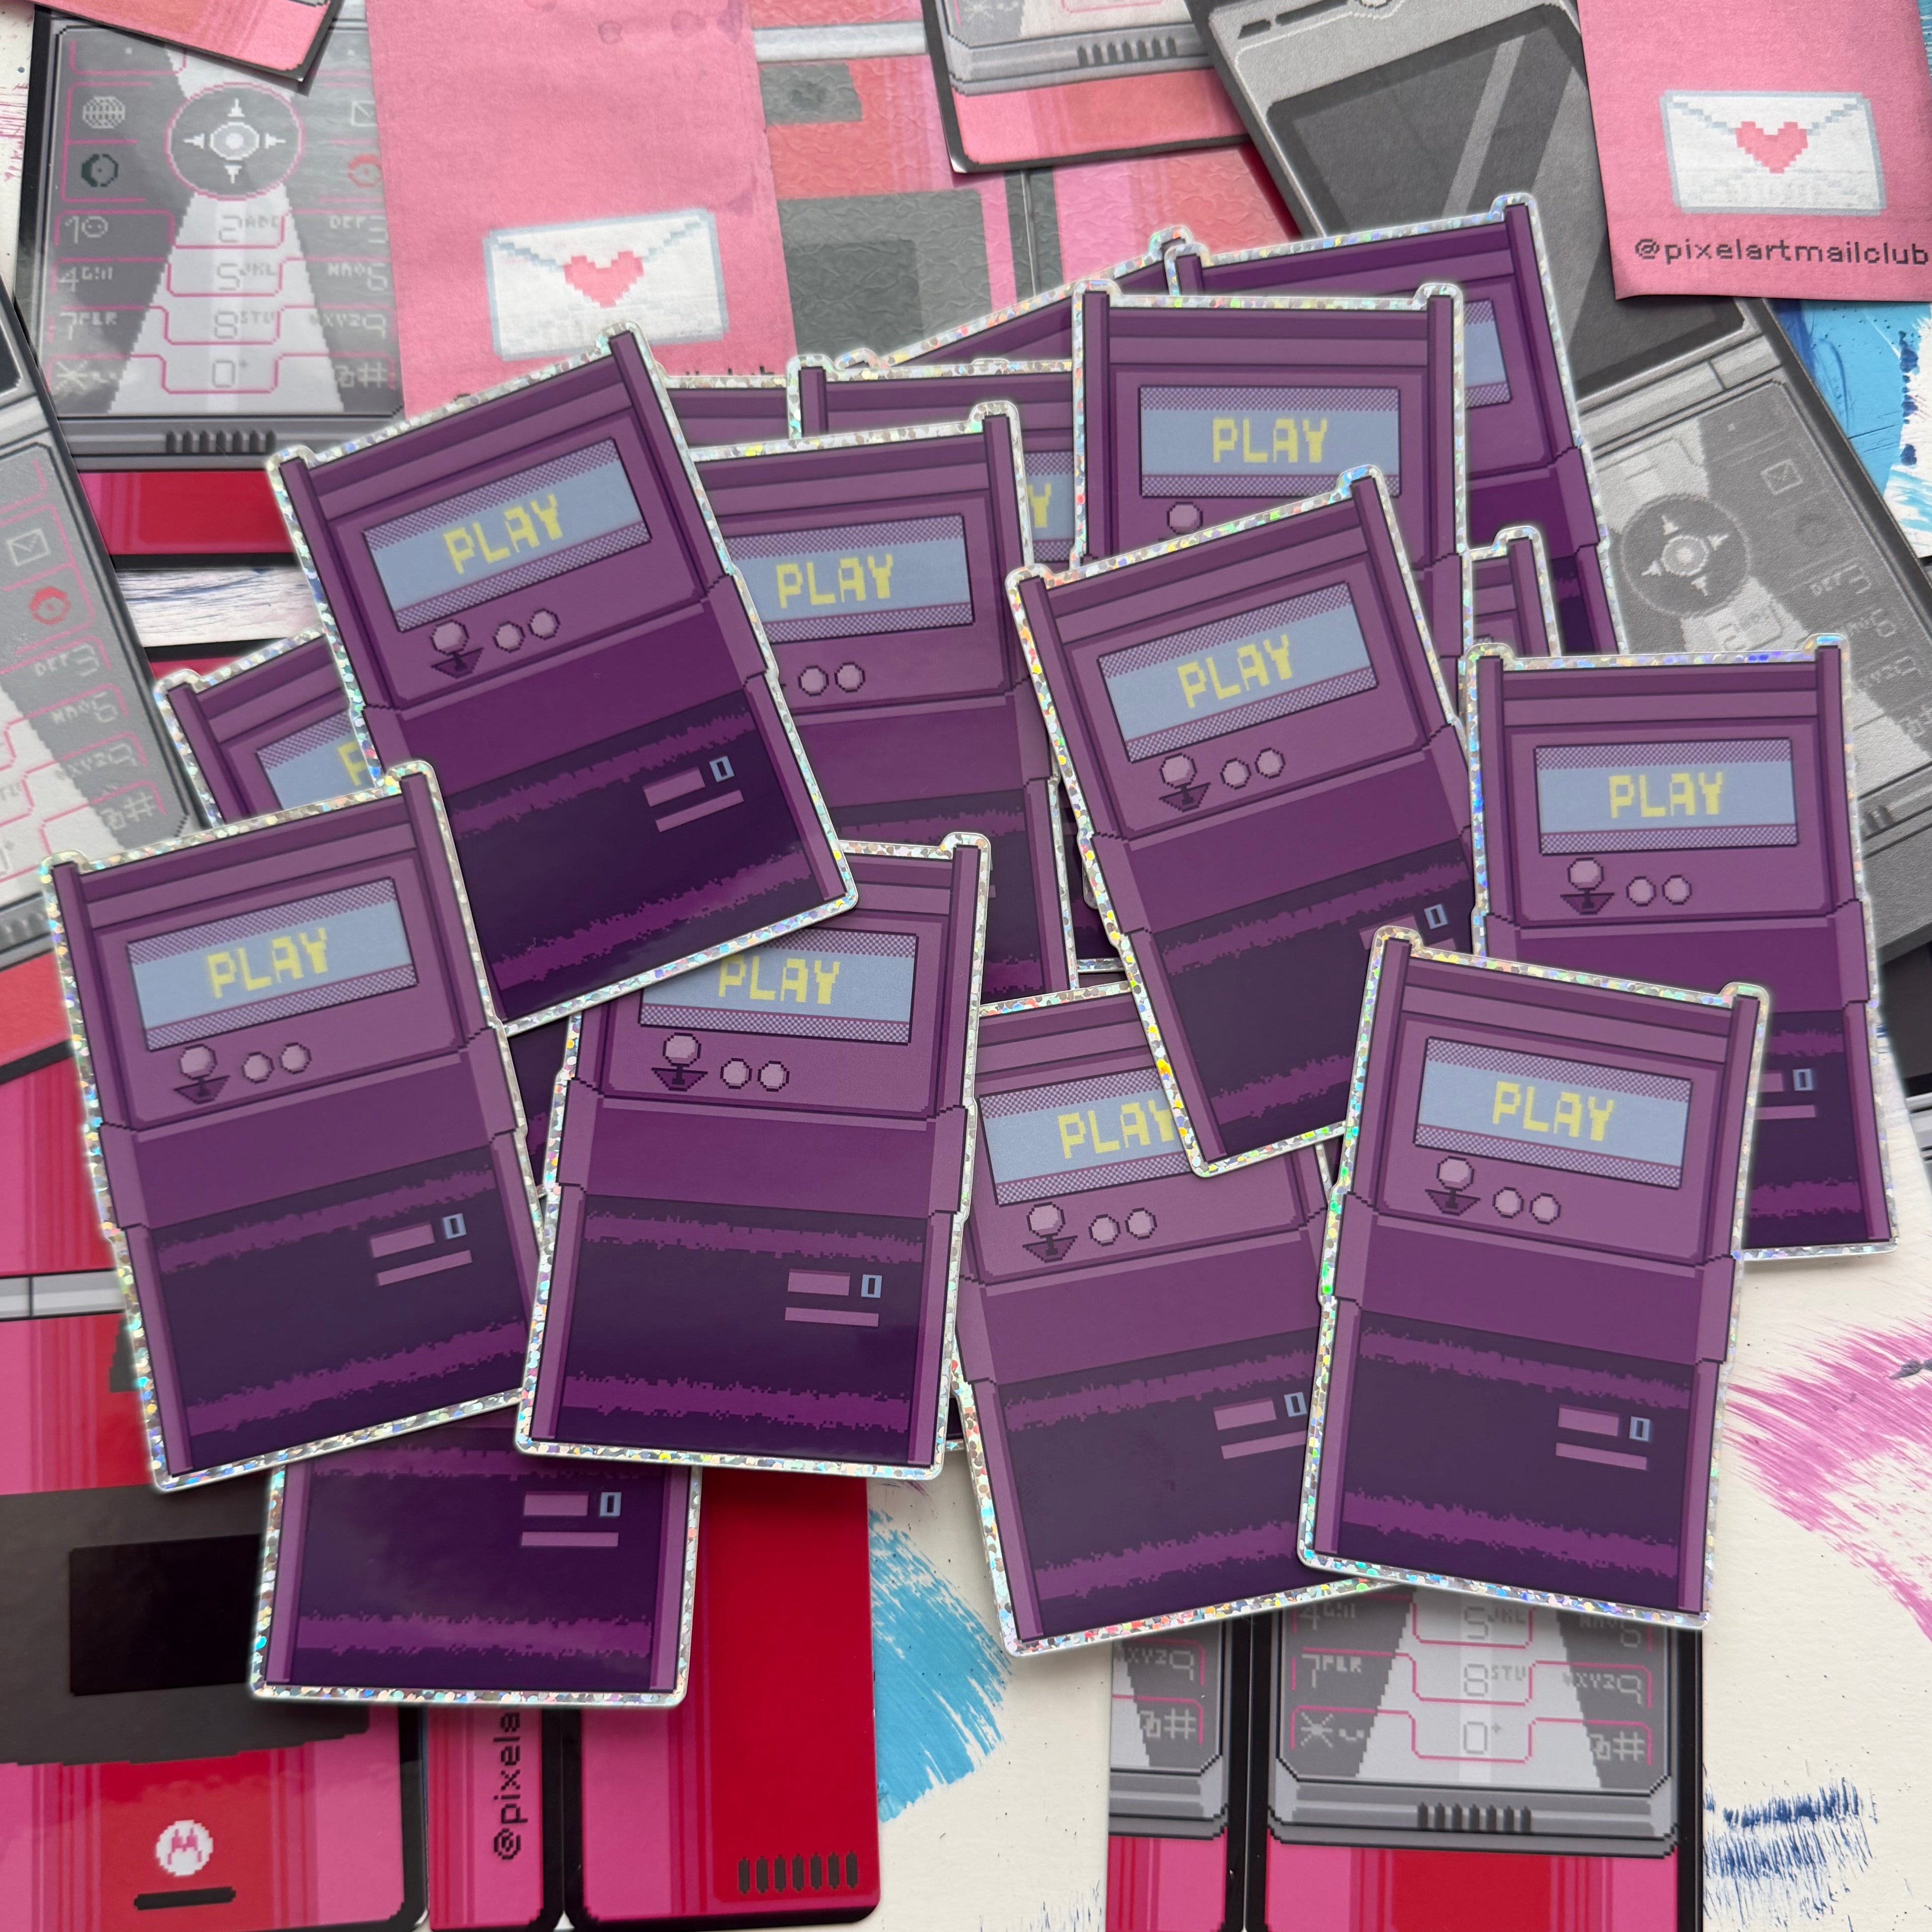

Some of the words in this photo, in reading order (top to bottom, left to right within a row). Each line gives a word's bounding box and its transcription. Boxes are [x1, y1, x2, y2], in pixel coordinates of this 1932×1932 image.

[1634, 238, 1928, 265] @pixelartmailclub
[1212, 418, 1328, 463] PLAY
[443, 494, 564, 575] PLAY
[775, 554, 893, 608] PLAY
[1176, 635, 1293, 708] PLAY
[1608, 772, 1724, 819] PLAY
[207, 927, 328, 998] PLAY
[718, 954, 840, 1004] PLAY
[1493, 1081, 1614, 1142] PLAY
